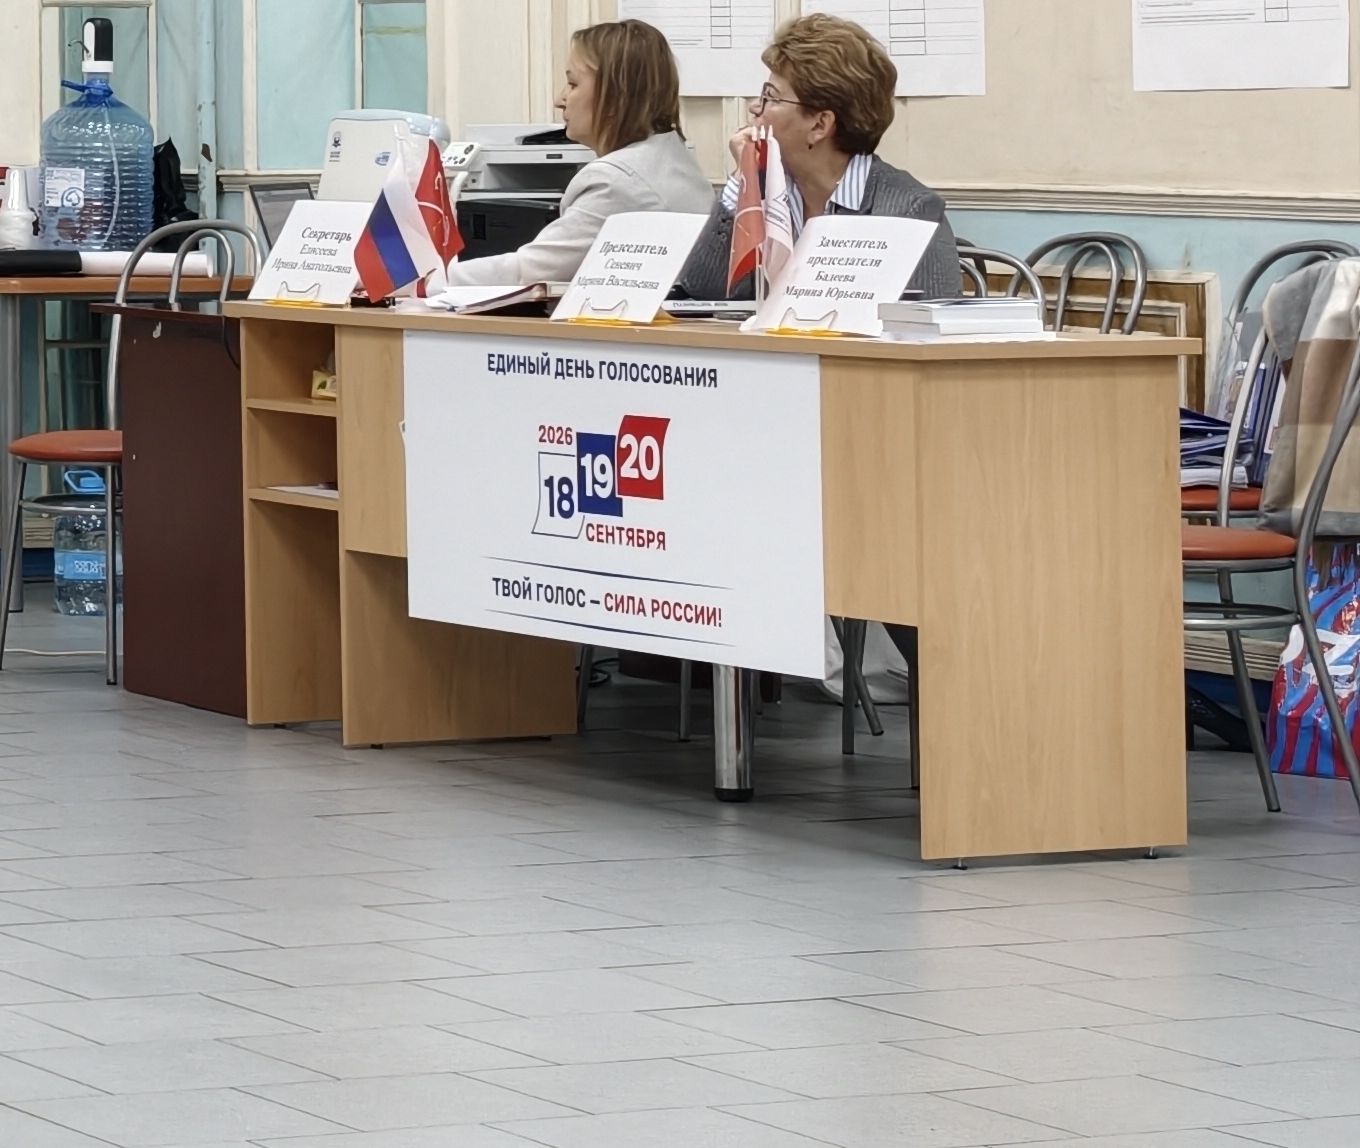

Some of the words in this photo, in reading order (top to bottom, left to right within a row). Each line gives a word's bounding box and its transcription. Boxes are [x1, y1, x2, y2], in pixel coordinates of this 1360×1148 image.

[301, 227, 352, 243] Секретарь
[816, 236, 888, 250] Заместитель
[599, 241, 668, 256] Председатель
[807, 256, 883, 268] председателя
[783, 285, 823, 299] Марина
[825, 287, 875, 301] Юрьевна
[487, 352, 551, 376] ЕДИНЫЙ
[554, 358, 595, 381] ДЕНЬ
[598, 360, 718, 388] ГОЛОСОВАНИЯ
[537, 425, 573, 446] 2026
[619, 433, 661, 481] 20
[580, 453, 614, 499] 19
[544, 475, 575, 519] 18
[585, 522, 666, 551] СЕНТЯБРЯ
[492, 577, 532, 602] ТВОЙ
[536, 583, 586, 609] ГОЛОС
[604, 592, 647, 618] СИЛА
[651, 599, 722, 627] РОССИИ!
